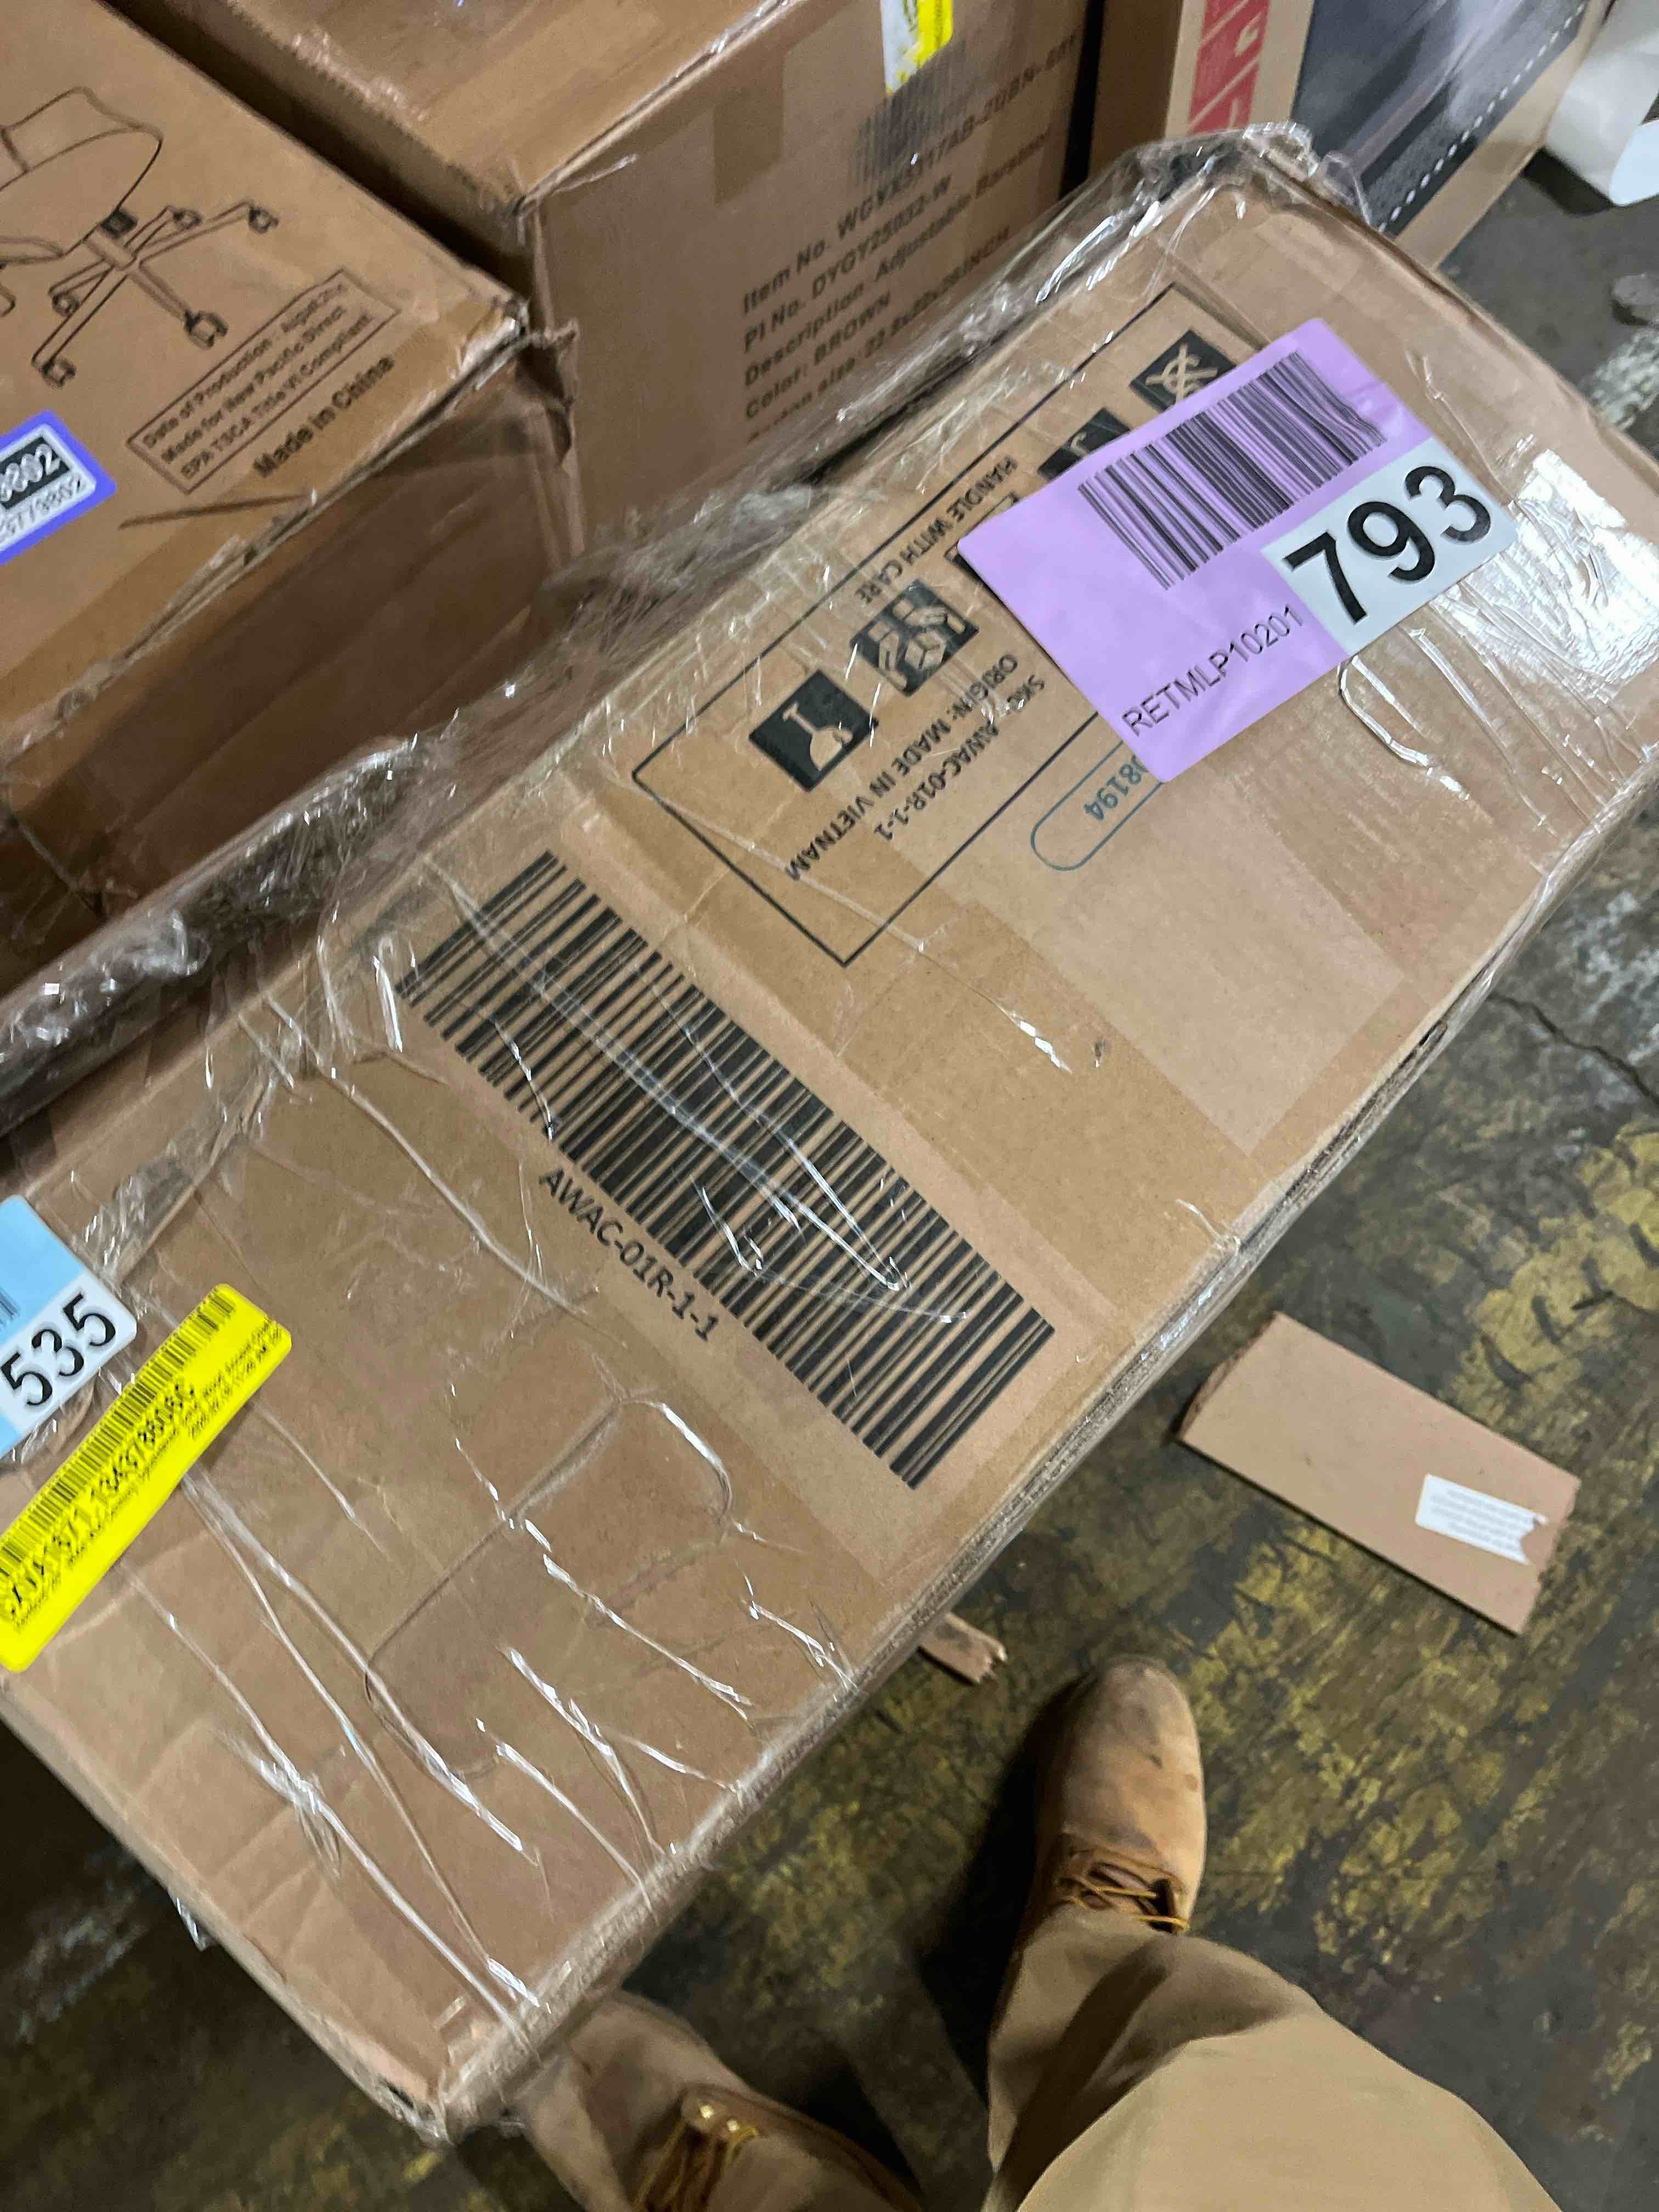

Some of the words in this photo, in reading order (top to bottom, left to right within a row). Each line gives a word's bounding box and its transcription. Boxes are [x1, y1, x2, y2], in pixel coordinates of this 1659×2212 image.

[743, 268, 791, 314] Item
[814, 291, 891, 365] BROWN
[253, 426, 313, 478] Made
[309, 406, 336, 431] in
[331, 357, 394, 409] China
[947, 456, 1018, 522] HANDLE
[900, 518, 952, 566] WITH
[1282, 465, 1493, 625] 793
[854, 560, 903, 605] CARE
[950, 654, 1019, 721] ORIGIN:
[1121, 603, 1306, 735] RETMLP10201
[873, 722, 1000, 843] AWAC-01R-1-1
[890, 718, 952, 777] MADE
[868, 774, 896, 799] IN
[785, 795, 874, 882] VIETNAM
[538, 1167, 719, 1342] AWAC-01R-1-1
[0, 1293, 116, 1407] 535
